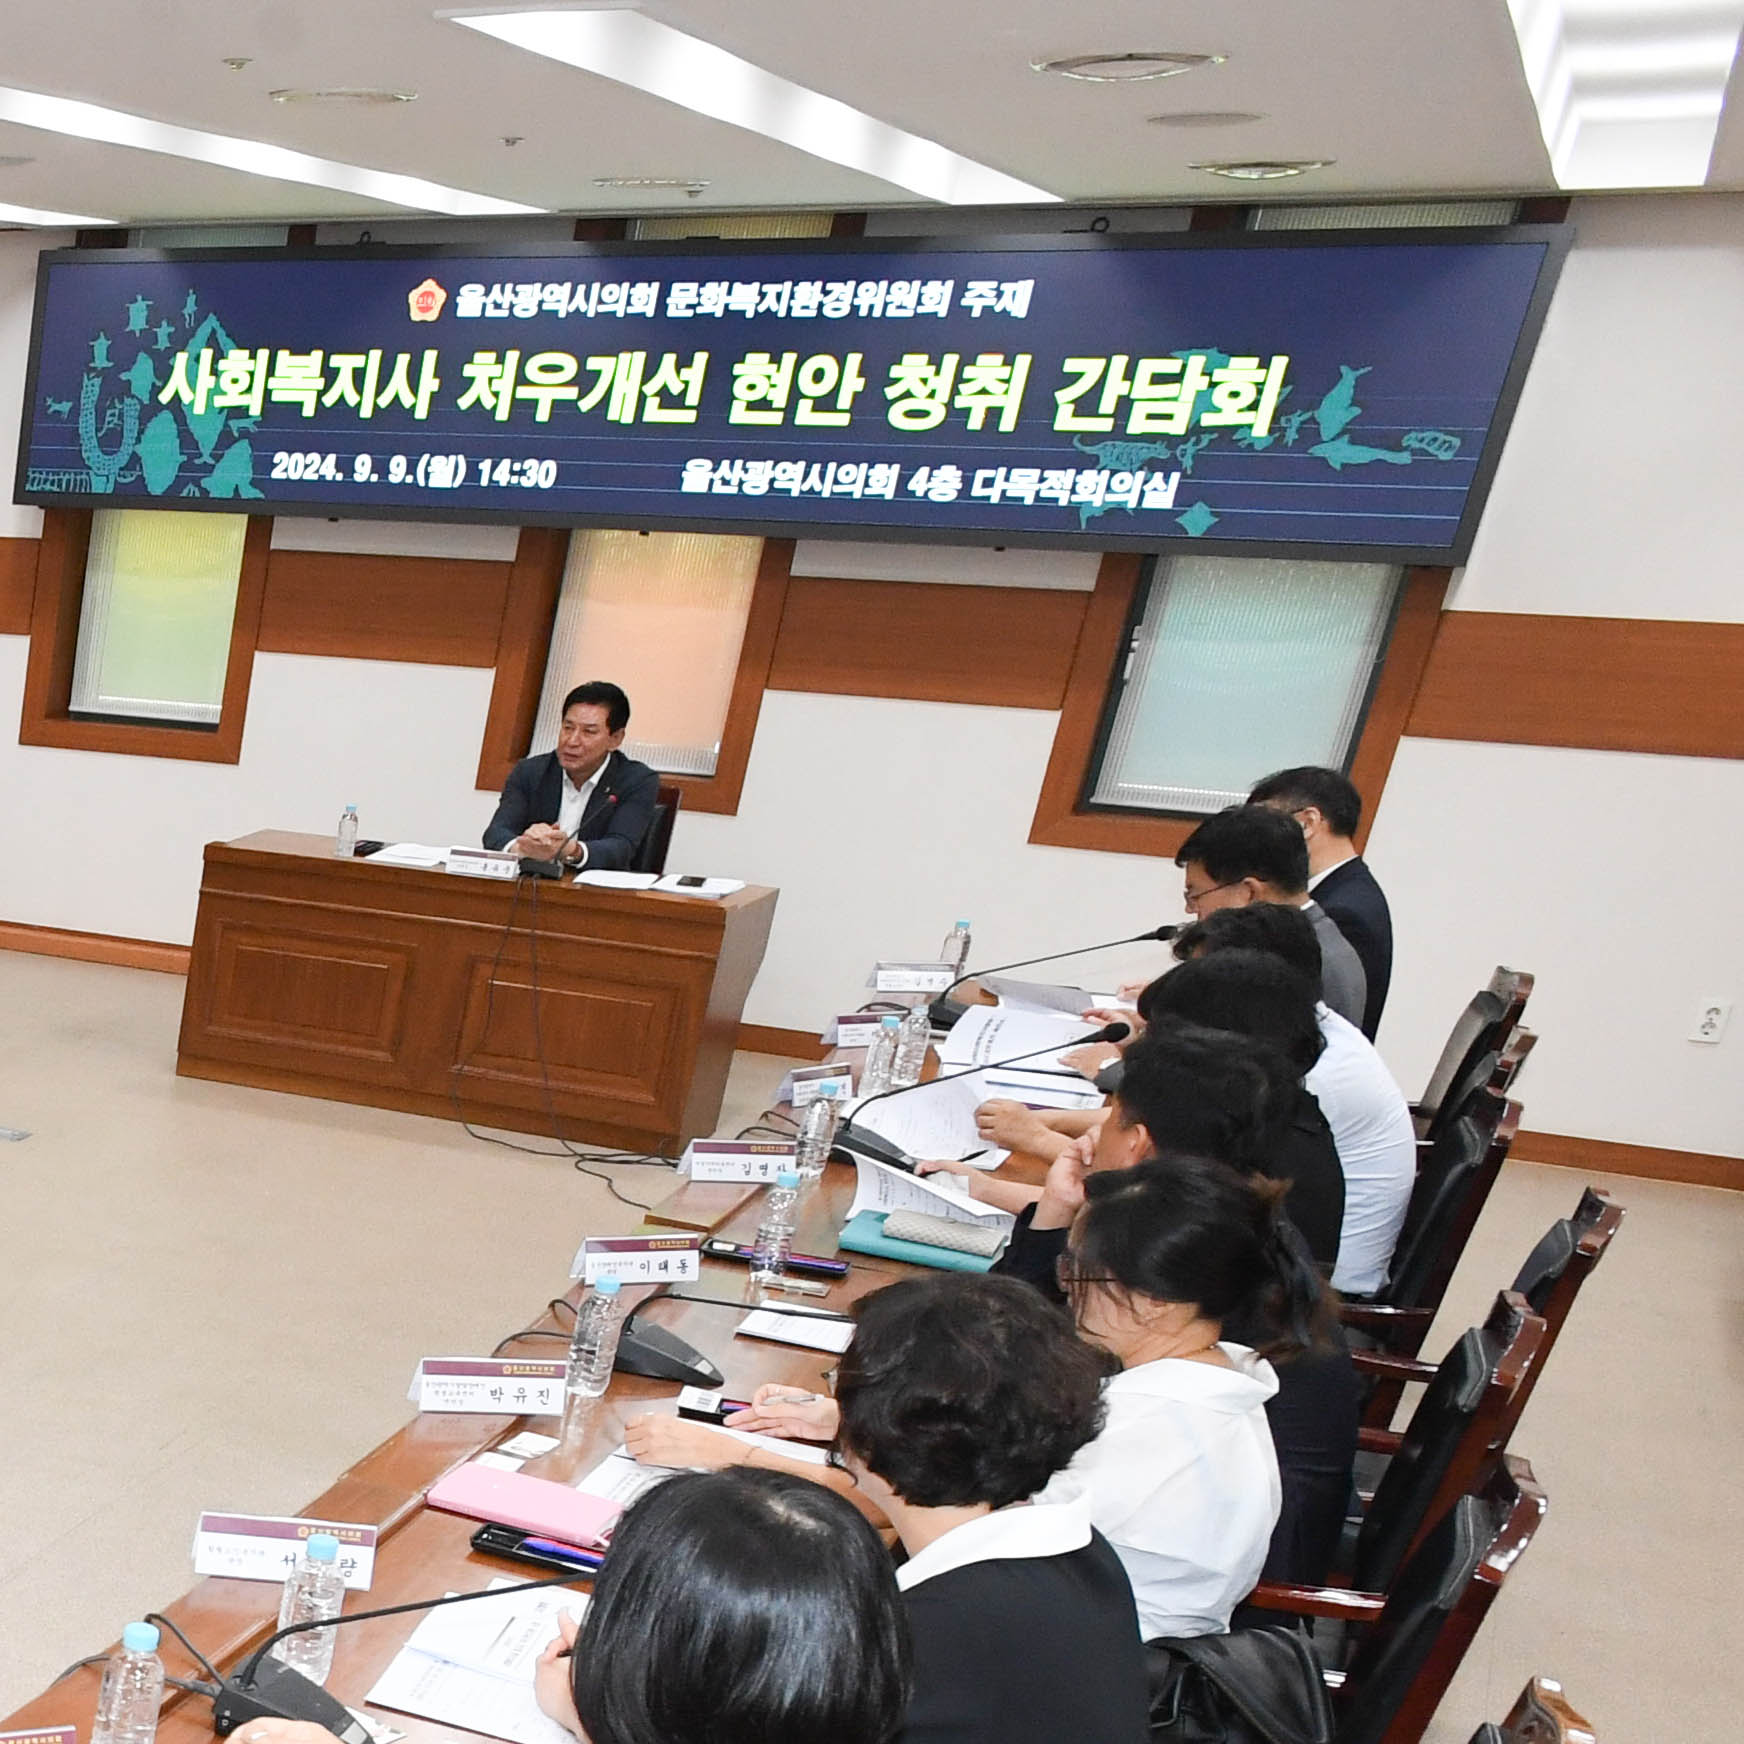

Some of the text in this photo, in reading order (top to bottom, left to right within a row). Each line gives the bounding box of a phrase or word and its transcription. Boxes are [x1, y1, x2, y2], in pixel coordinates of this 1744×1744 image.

[456, 281, 661, 319] 울산광역시의회
[665, 280, 955, 319] 문화복지환경위원회
[157, 348, 1290, 438] 사회복지사 처우개선 현안 청취 간담회
[271, 451, 343, 481] 2024.
[352, 453, 379, 482] 9.
[477, 457, 558, 490] 14:30
[680, 458, 1181, 510] 울산광역시의회 4층 다목적회의실
